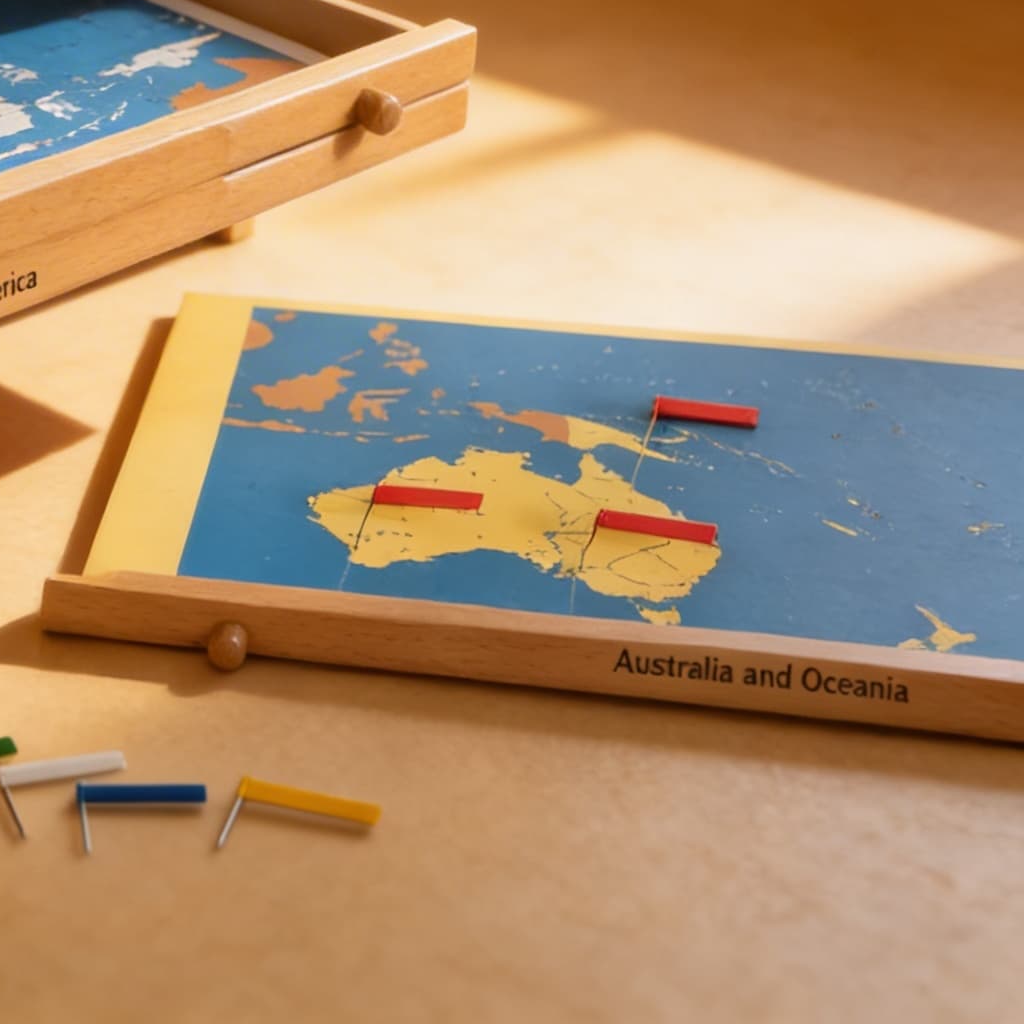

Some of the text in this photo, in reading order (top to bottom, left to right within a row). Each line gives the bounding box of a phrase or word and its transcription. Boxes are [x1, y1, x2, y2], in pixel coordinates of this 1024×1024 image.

[613, 648, 910, 704] Australia and Oceania
